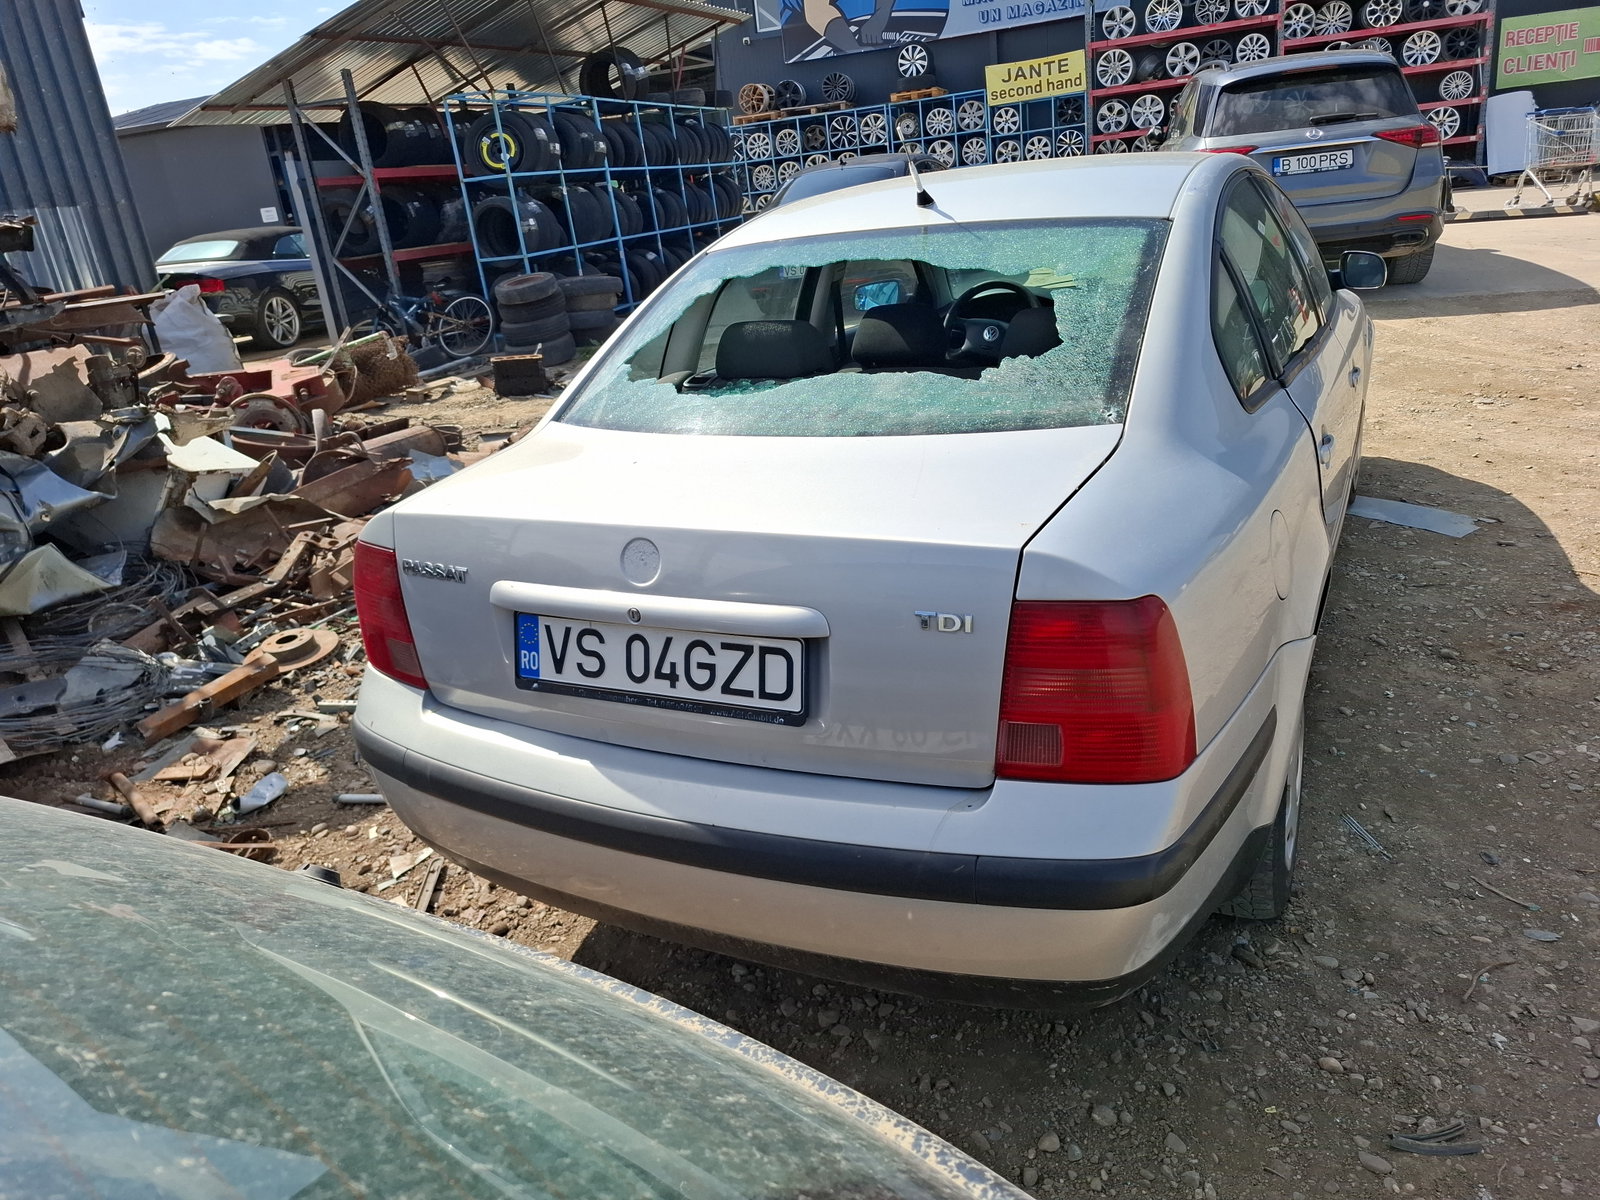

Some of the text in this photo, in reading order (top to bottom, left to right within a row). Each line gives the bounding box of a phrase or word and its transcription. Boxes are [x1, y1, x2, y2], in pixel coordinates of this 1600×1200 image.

[979, 8, 1002, 24] UN
[1001, 58, 1070, 83] JANTE
[990, 73, 1083, 101] second hand
[1281, 159, 1291, 172] B
[784, 266, 797, 276] VS
[402, 558, 468, 584] PASSAT
[914, 610, 974, 633] TDI
[520, 650, 539, 671] RO
[543, 624, 794, 702] VS 04GZD
